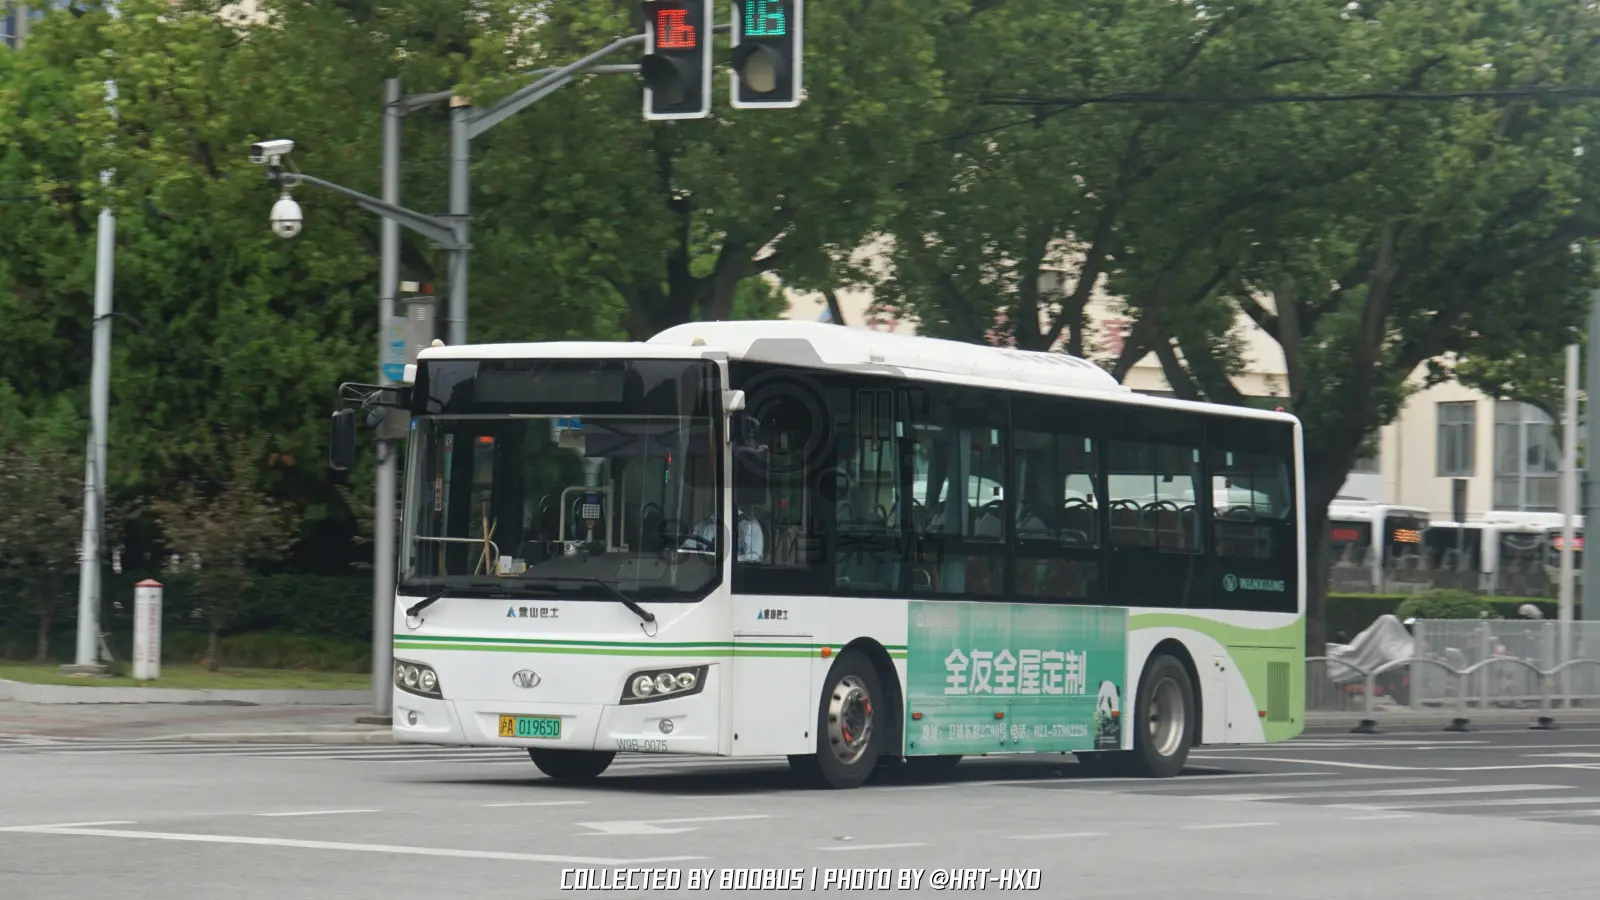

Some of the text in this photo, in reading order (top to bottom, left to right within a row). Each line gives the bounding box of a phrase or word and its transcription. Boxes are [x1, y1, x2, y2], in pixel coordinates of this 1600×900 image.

[657, 9, 696, 48] 06
[518, 606, 560, 619] 金山巴士
[943, 648, 1087, 695] 全友全屋定制
[519, 719, 560, 736] 01965D
[616, 738, 668, 752] W9B-0075
